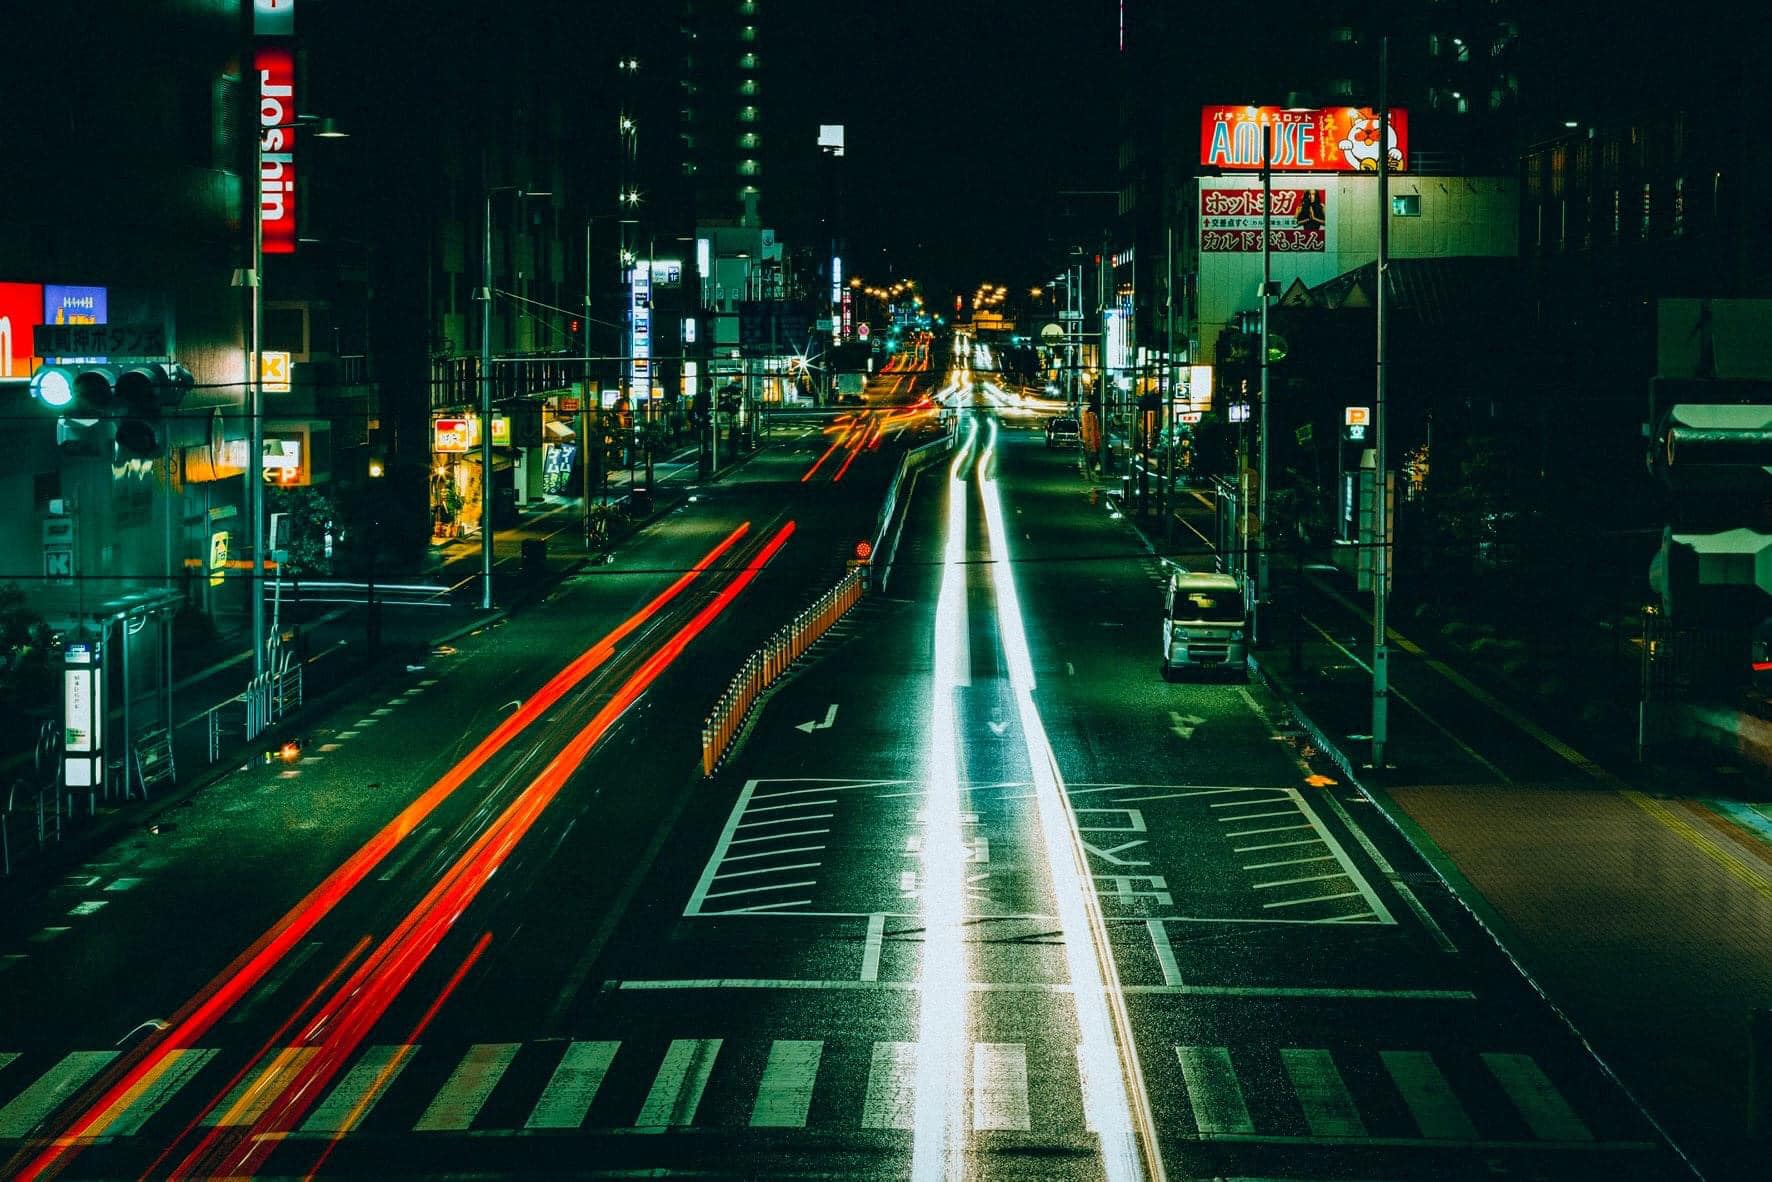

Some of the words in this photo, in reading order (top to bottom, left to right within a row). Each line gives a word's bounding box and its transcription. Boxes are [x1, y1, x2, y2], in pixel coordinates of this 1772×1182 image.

[261, 69, 293, 221] Joshin
[1208, 120, 1315, 166] AMUSE
[1206, 190, 1297, 215] ホットヨガ
[1350, 410, 1366, 424] P
[281, 467, 297, 483] P
